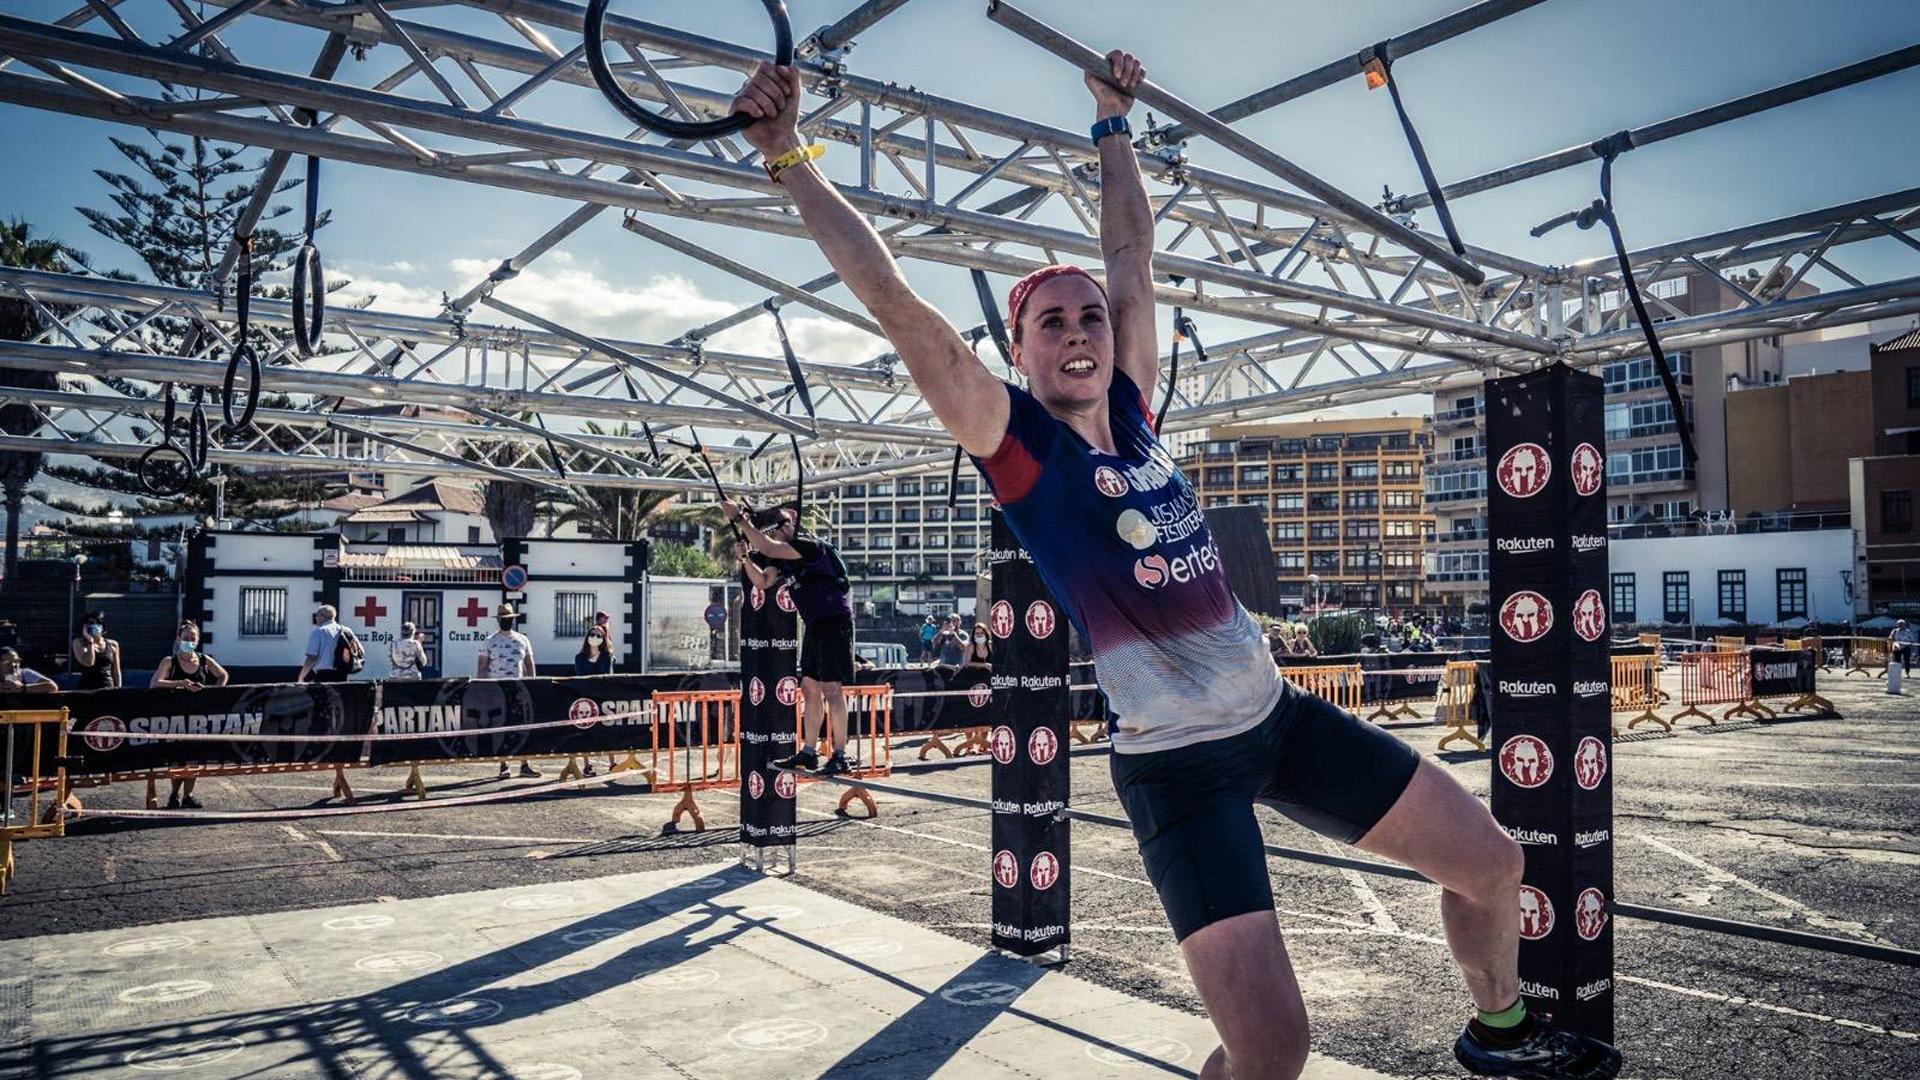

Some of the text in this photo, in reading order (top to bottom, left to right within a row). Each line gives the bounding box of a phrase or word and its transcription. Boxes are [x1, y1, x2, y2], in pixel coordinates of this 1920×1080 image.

[1497, 537, 1554, 554] Rakuten
[1572, 534, 1606, 552] Rakuten
[372, 630, 394, 645] Roja
[449, 631, 471, 642] Cruz
[1764, 662, 1798, 680] SPARTAN
[991, 674, 1018, 689] akuten
[1021, 675, 1062, 691] Rakuten
[1500, 680, 1556, 697] Rakuten
[1573, 681, 1608, 698] Rakuten
[129, 703, 263, 746] SPARTAN
[376, 704, 461, 734] PARTAN
[992, 798, 1021, 814] akuten
[1575, 830, 1609, 849] Rakuten
[1024, 925, 1065, 942] Rakuten
[1519, 976, 1559, 1000] kuten
[1576, 978, 1611, 1001] Rakuten
